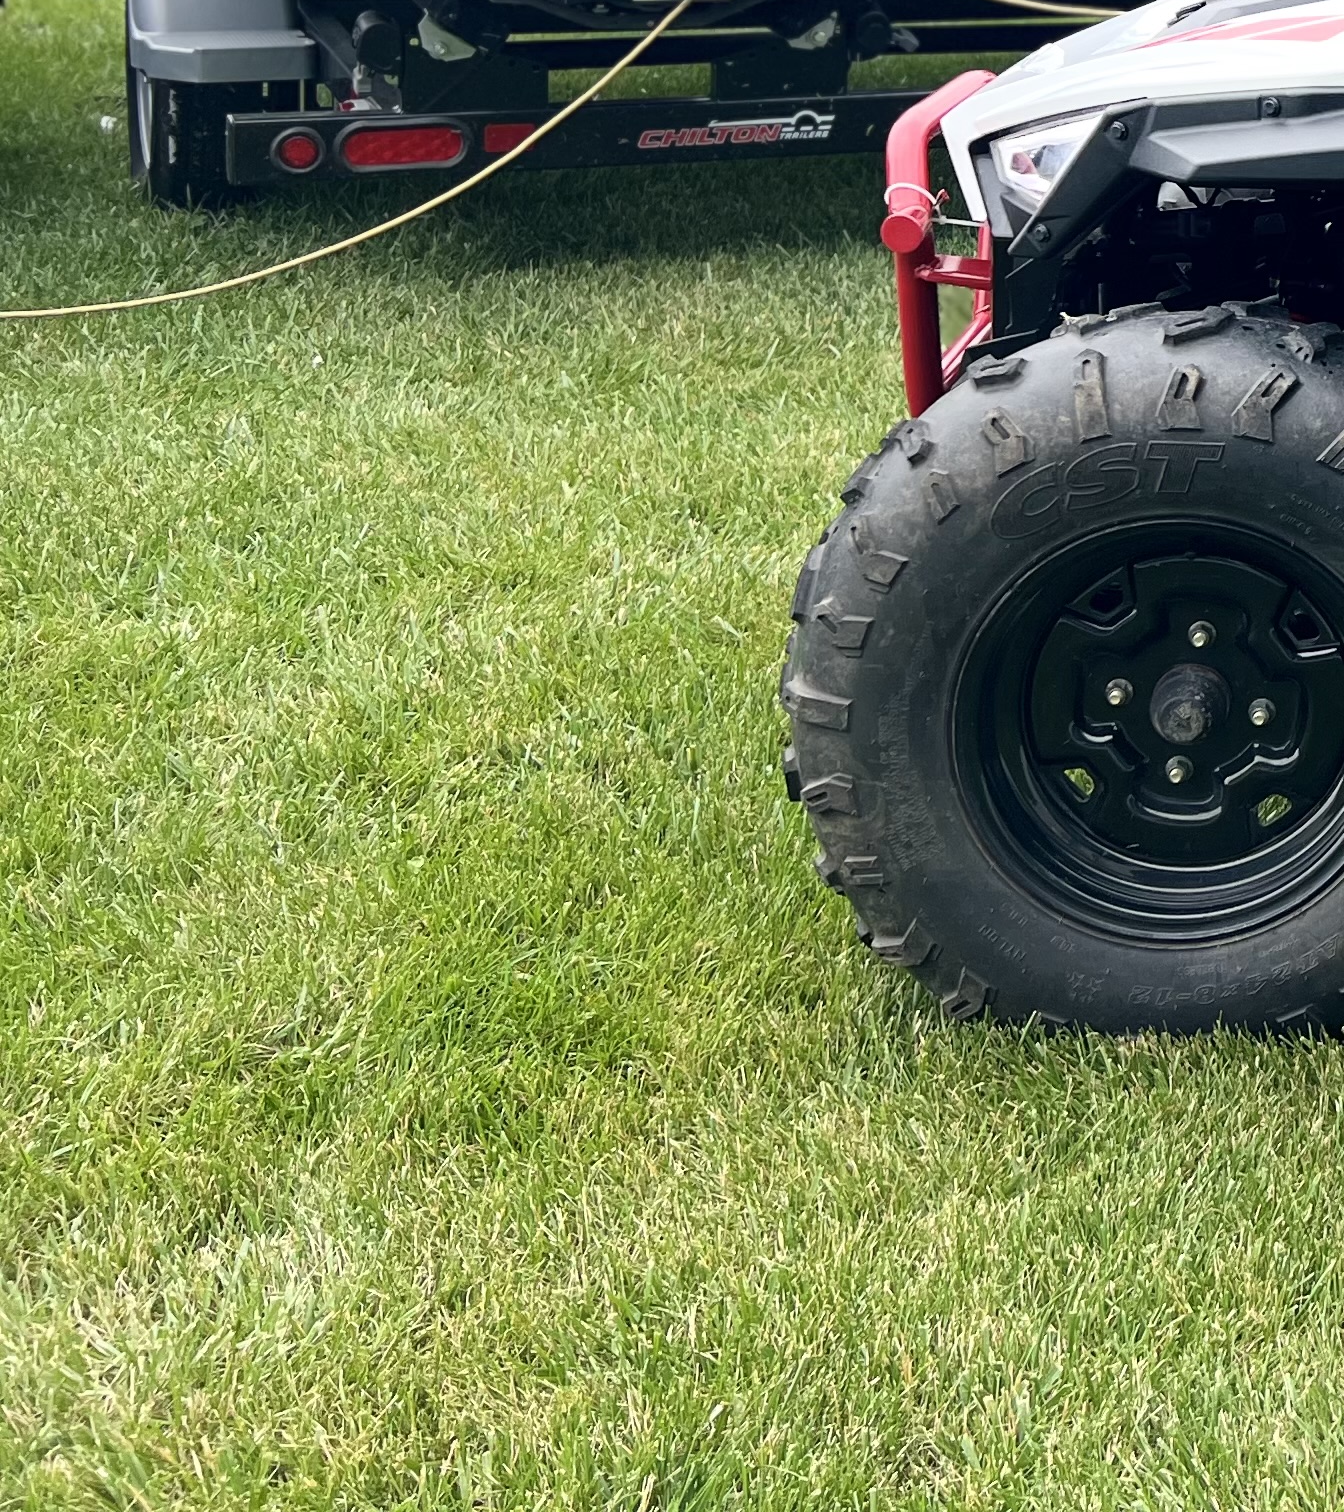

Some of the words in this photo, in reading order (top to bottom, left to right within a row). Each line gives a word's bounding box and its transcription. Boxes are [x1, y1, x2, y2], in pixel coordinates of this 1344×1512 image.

[637, 124, 782, 149] CHILTON
[780, 131, 830, 140] TRAILERS
[990, 440, 1226, 538] CST
